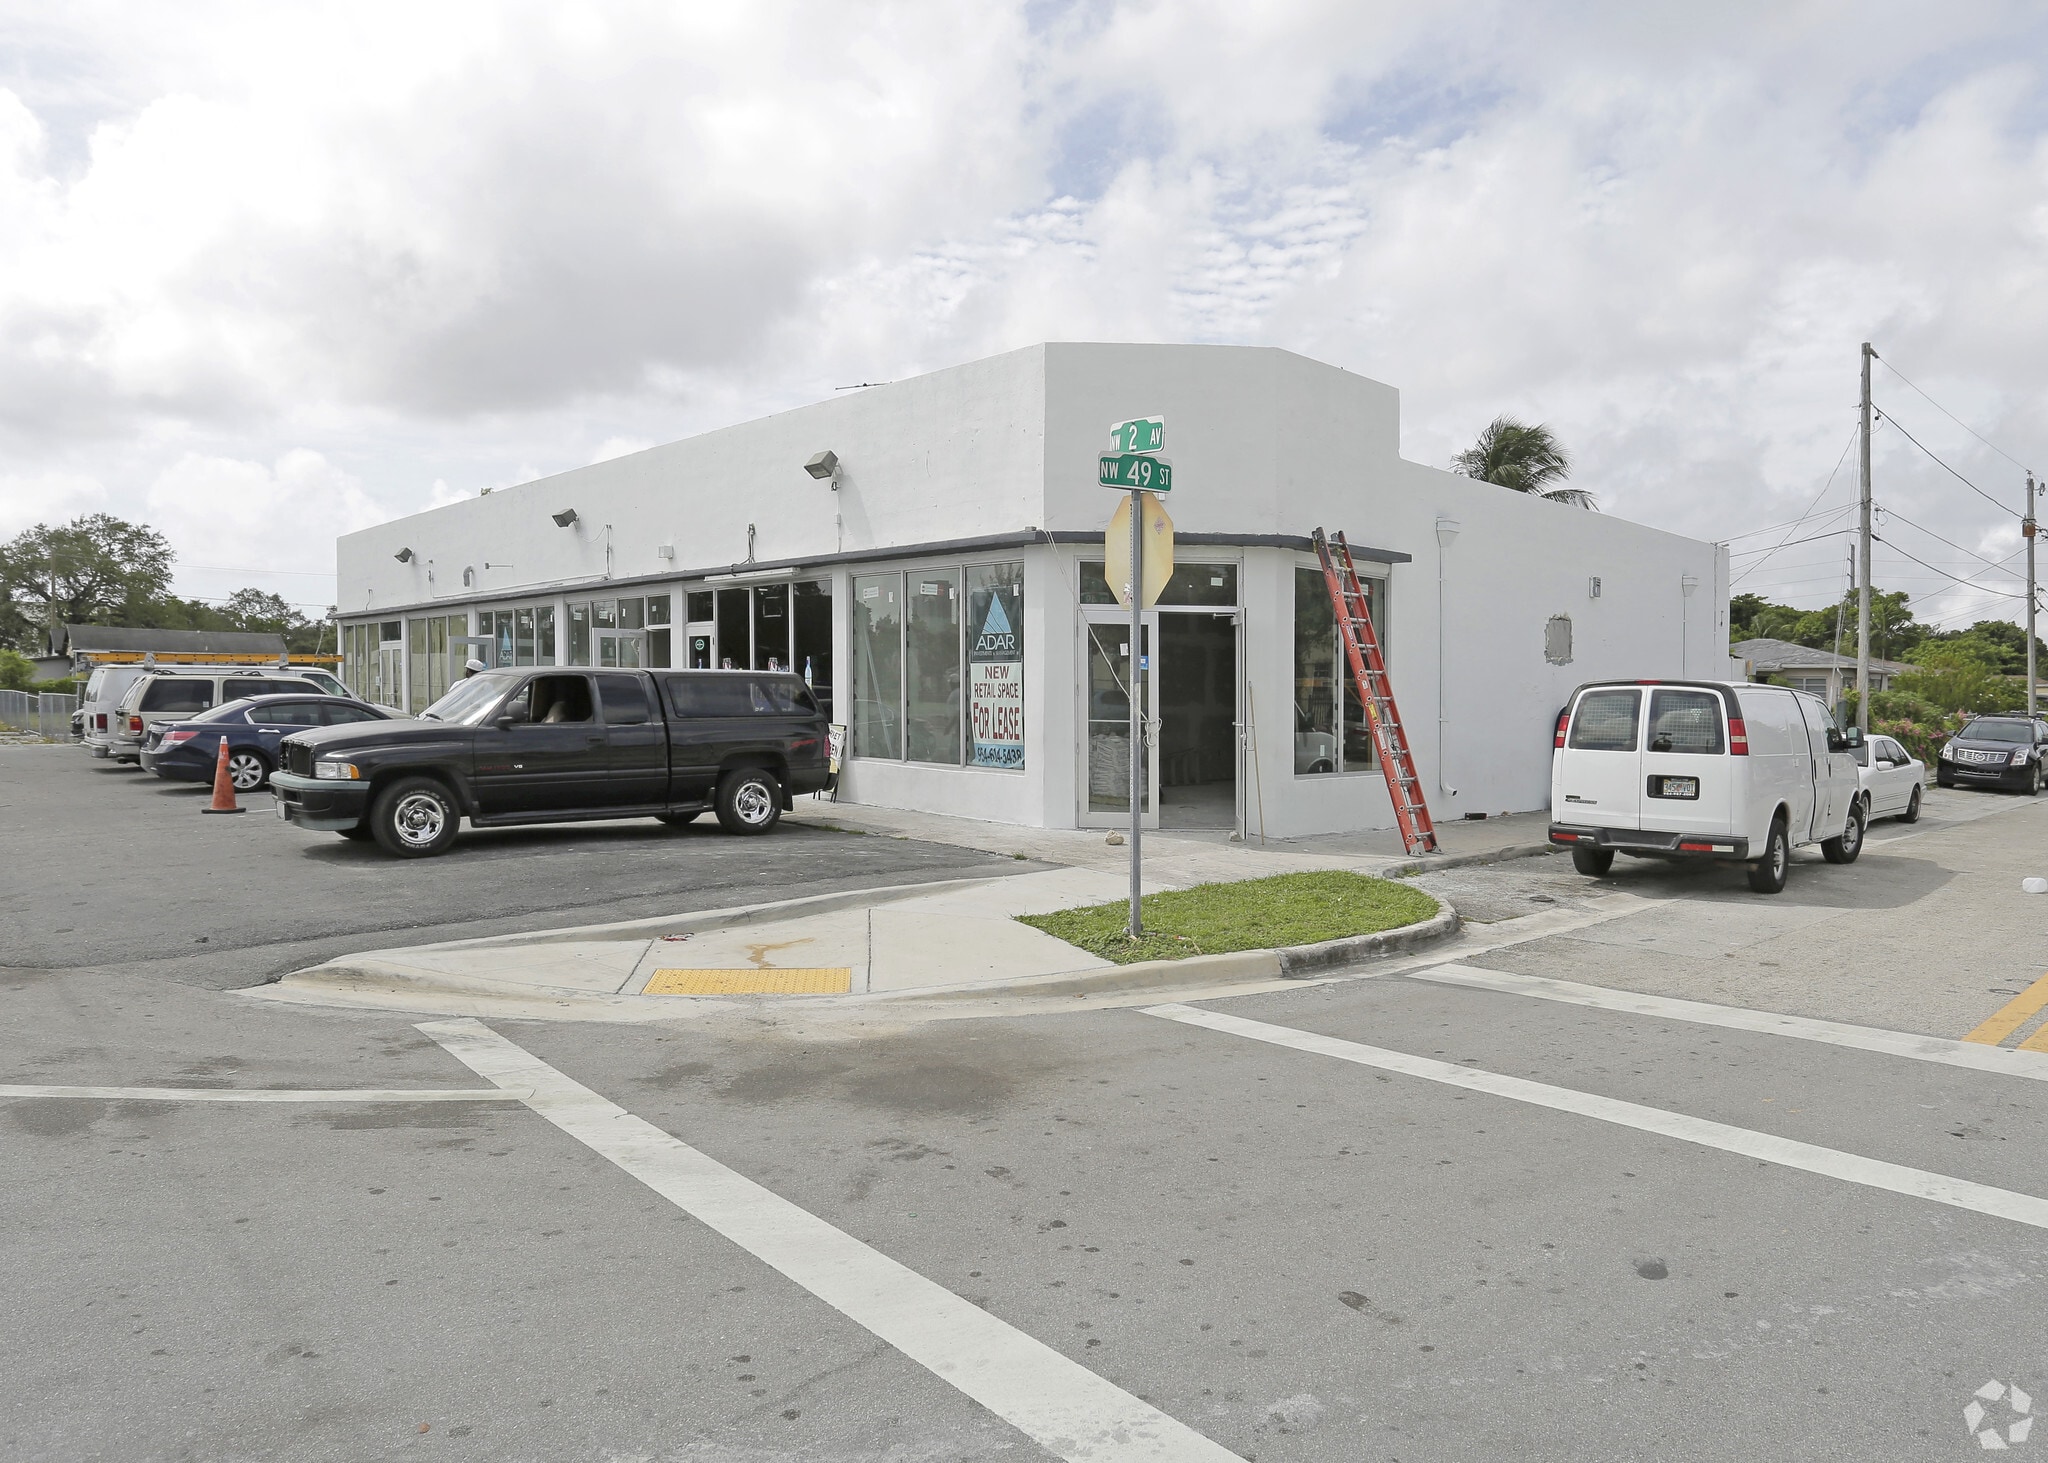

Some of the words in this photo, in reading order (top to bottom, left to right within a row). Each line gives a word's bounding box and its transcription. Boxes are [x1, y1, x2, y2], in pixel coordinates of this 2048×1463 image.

[1111, 434, 1121, 451] NW
[1129, 425, 1138, 451] 2
[1149, 427, 1162, 446] AV
[1100, 461, 1119, 479] NW
[1126, 460, 1152, 487] 49
[1159, 467, 1170, 486] ST
[975, 634, 1016, 650] ADAR
[984, 665, 1010, 680] NEW
[974, 682, 996, 699] RETAIL
[997, 682, 1019, 699] SPACE
[973, 702, 990, 739] FOR
[992, 702, 1020, 740] LEASE
